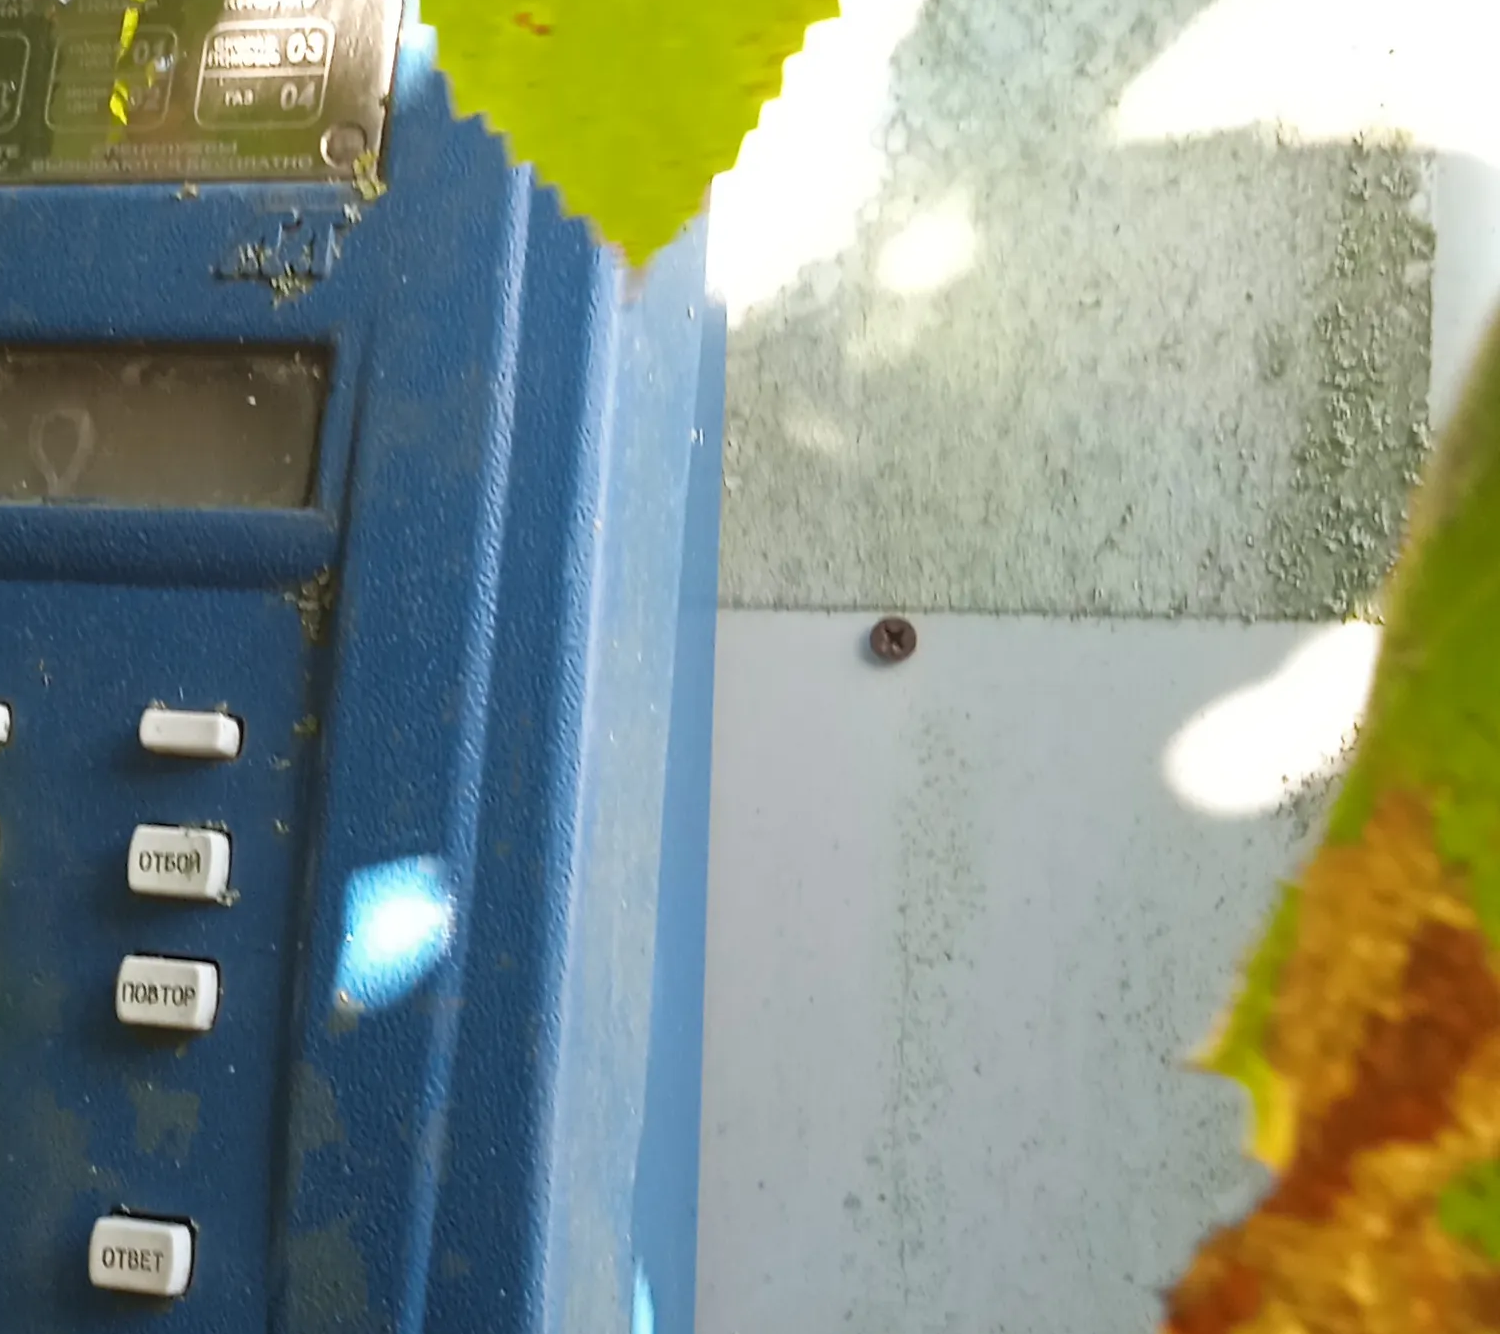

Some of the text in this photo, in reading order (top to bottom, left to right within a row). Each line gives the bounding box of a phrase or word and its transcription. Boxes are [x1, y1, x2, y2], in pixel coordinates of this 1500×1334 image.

[287, 32, 325, 64] 03
[281, 82, 315, 111] 04
[139, 850, 202, 877] ОТБОЙ
[121, 980, 197, 1008] ПОВТОР
[102, 1246, 165, 1273] ОТВЕТ
